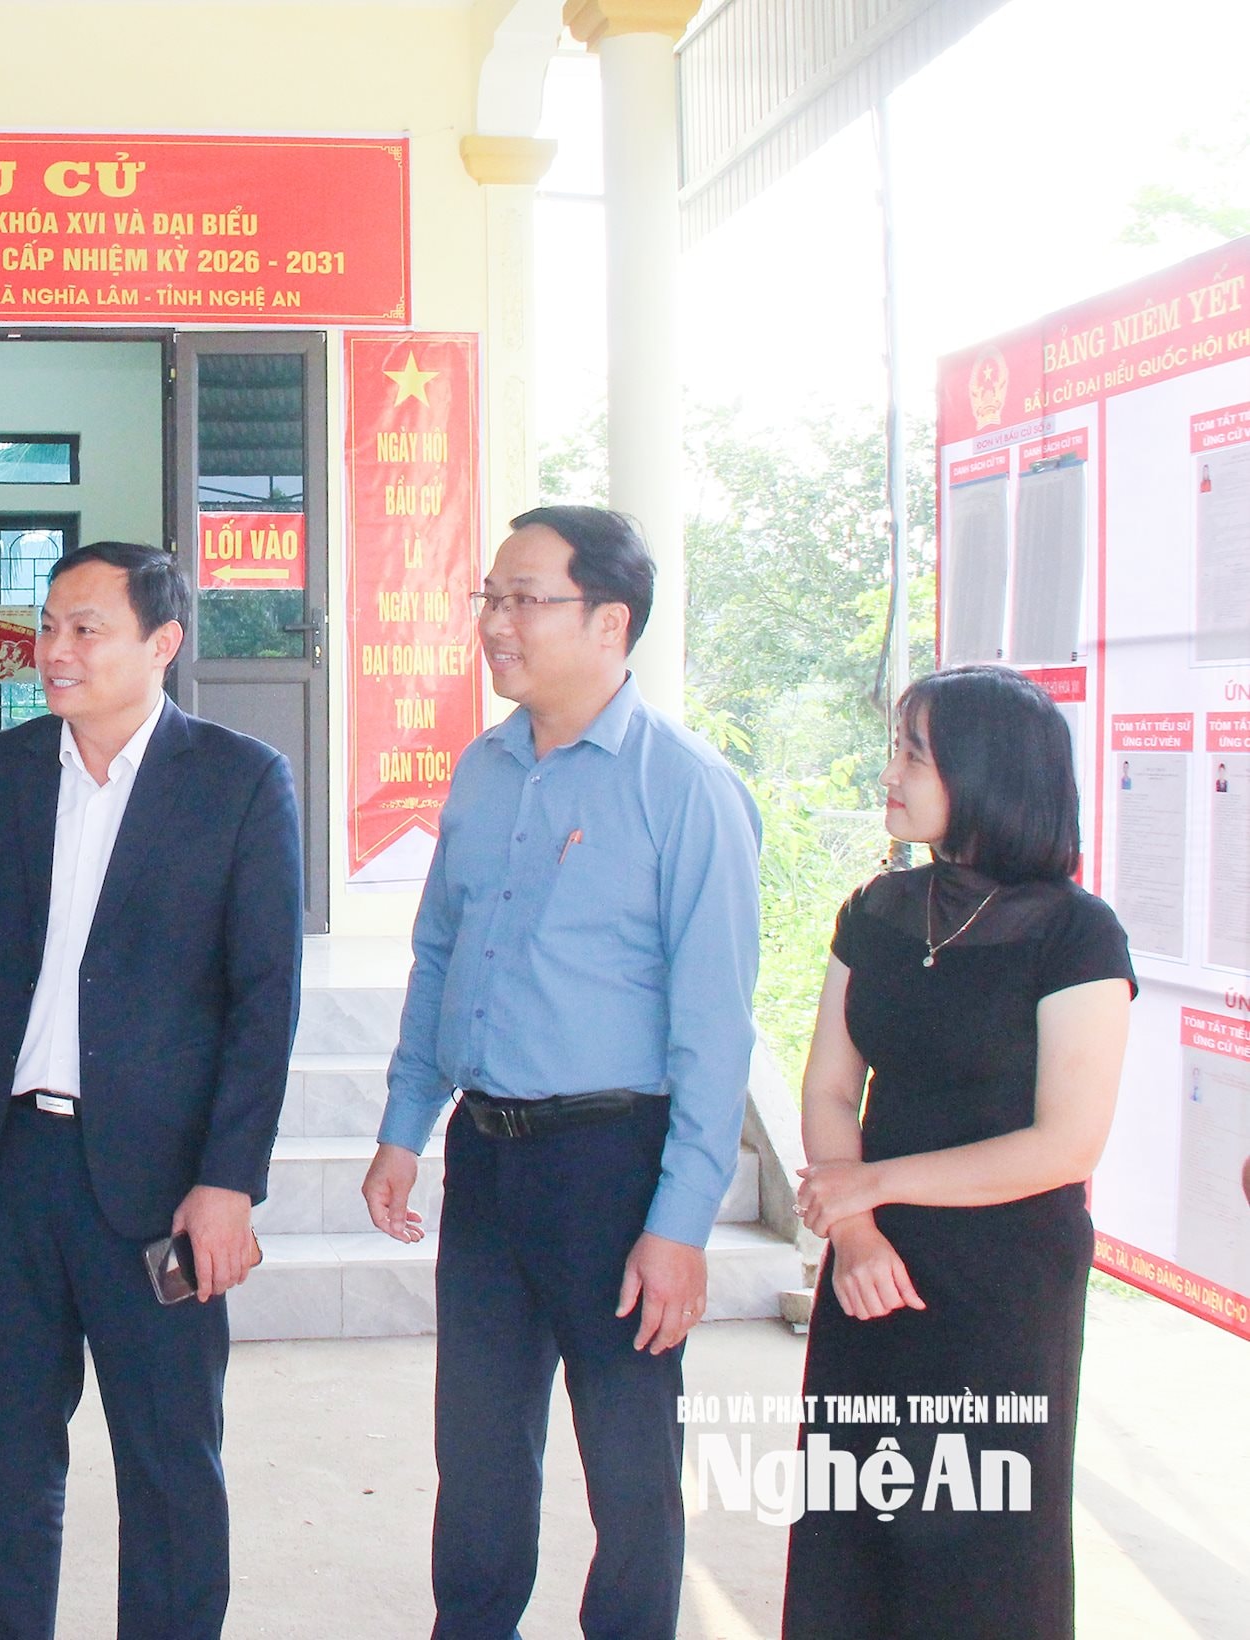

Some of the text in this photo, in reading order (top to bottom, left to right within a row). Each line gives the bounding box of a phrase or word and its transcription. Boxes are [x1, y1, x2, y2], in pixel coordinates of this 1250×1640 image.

[43, 151, 146, 198] CỬ
[66, 212, 105, 235] XVI
[113, 208, 146, 235] VÀ
[153, 213, 194, 239] ĐẠI
[202, 205, 258, 236] BIỂU
[2, 239, 54, 271] CẤP
[63, 243, 148, 276] NHIỆM
[156, 244, 189, 273] KỲ
[197, 249, 260, 273] 2026
[286, 251, 345, 274] 2031
[22, 284, 90, 305] NGHĨA
[96, 284, 139, 305] LÂM
[156, 284, 202, 306] TỈNH
[209, 286, 265, 311] NGHỆ
[271, 290, 301, 307] AN
[1043, 324, 1107, 374] BẢNG
[1188, 264, 1246, 323] YẾT
[1053, 379, 1072, 404] CỬ
[1076, 377, 1100, 398] ĐẠI
[1104, 359, 1134, 388] BIỂU
[1137, 345, 1188, 377] QUỐC
[1191, 335, 1222, 361] HỘI
[377, 426, 448, 469] NGÀY HỘI
[385, 475, 443, 516] BẦU CỬ
[205, 519, 298, 560] LỐI VÀO
[404, 532, 423, 569] LÀ
[379, 586, 449, 629] NGÀY HỘI
[362, 636, 467, 682] ĐẠI ĐOÀN KẾT
[394, 692, 435, 729] TOÀN
[380, 745, 451, 788] DÂN TỘC!
